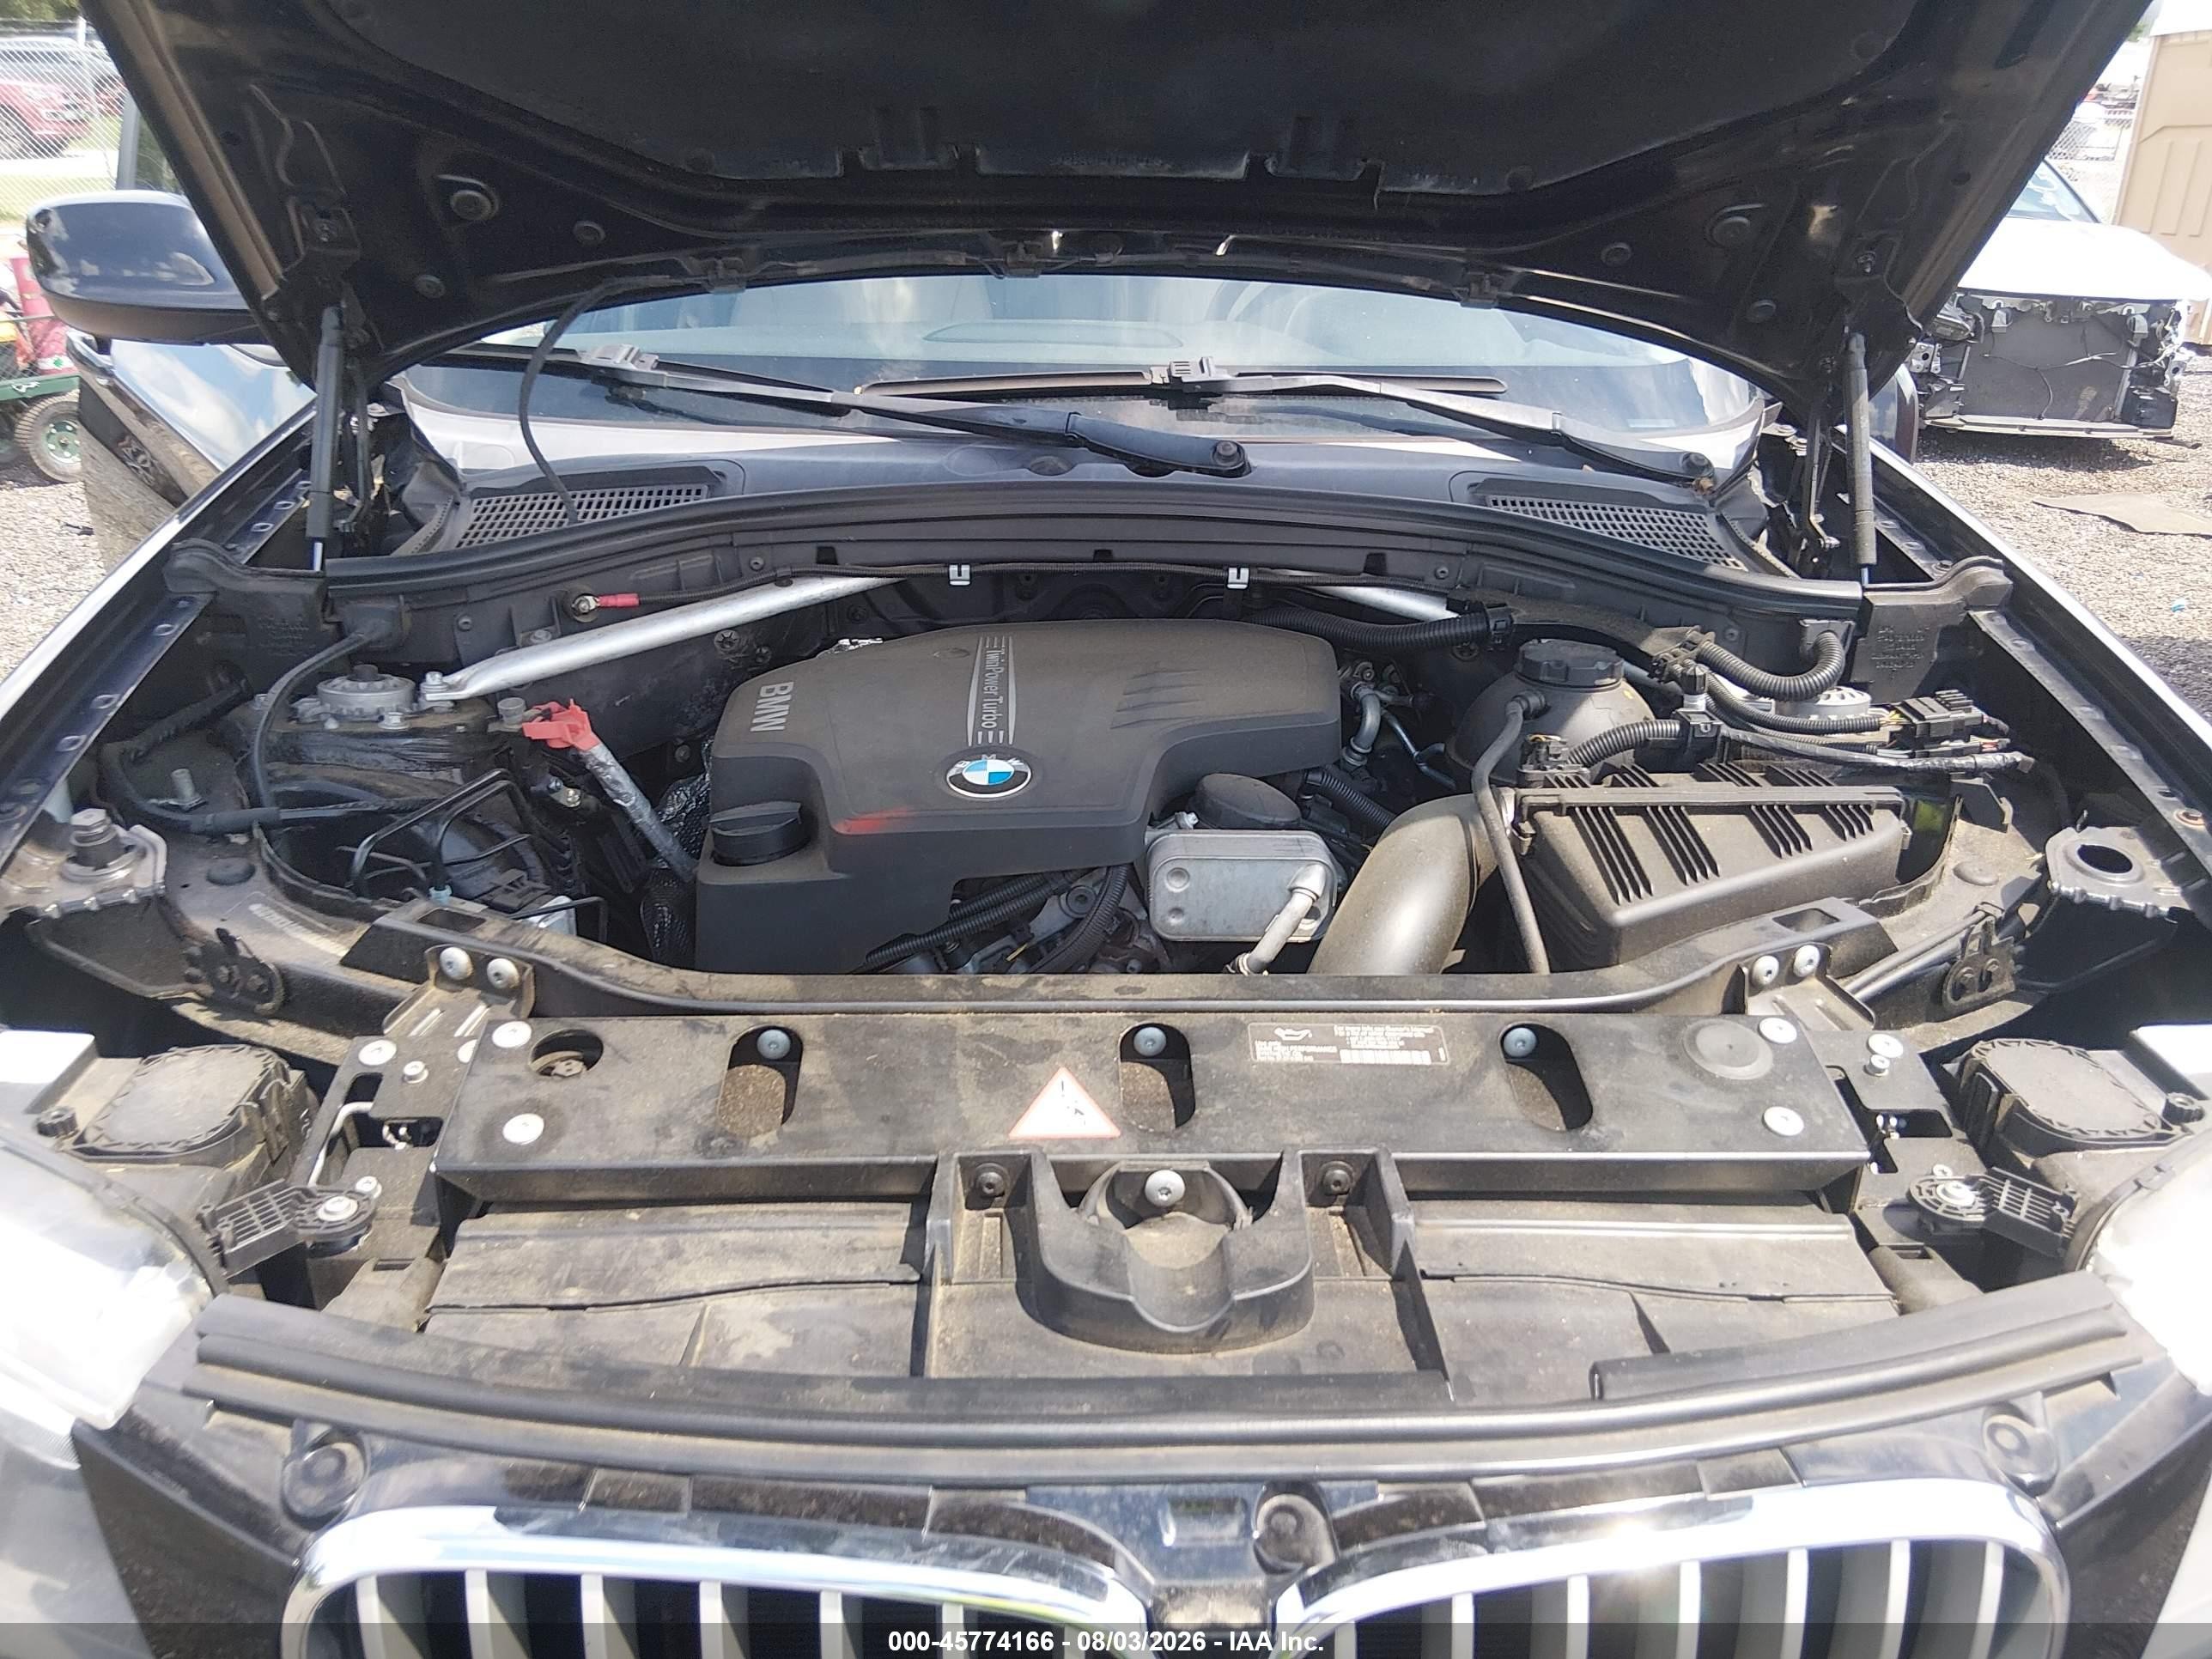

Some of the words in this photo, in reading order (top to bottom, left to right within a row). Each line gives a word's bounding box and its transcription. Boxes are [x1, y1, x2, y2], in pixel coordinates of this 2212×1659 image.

[982, 648, 1005, 695] TwinPower
[750, 682, 794, 732] BMW
[981, 696, 1003, 729] Turbo
